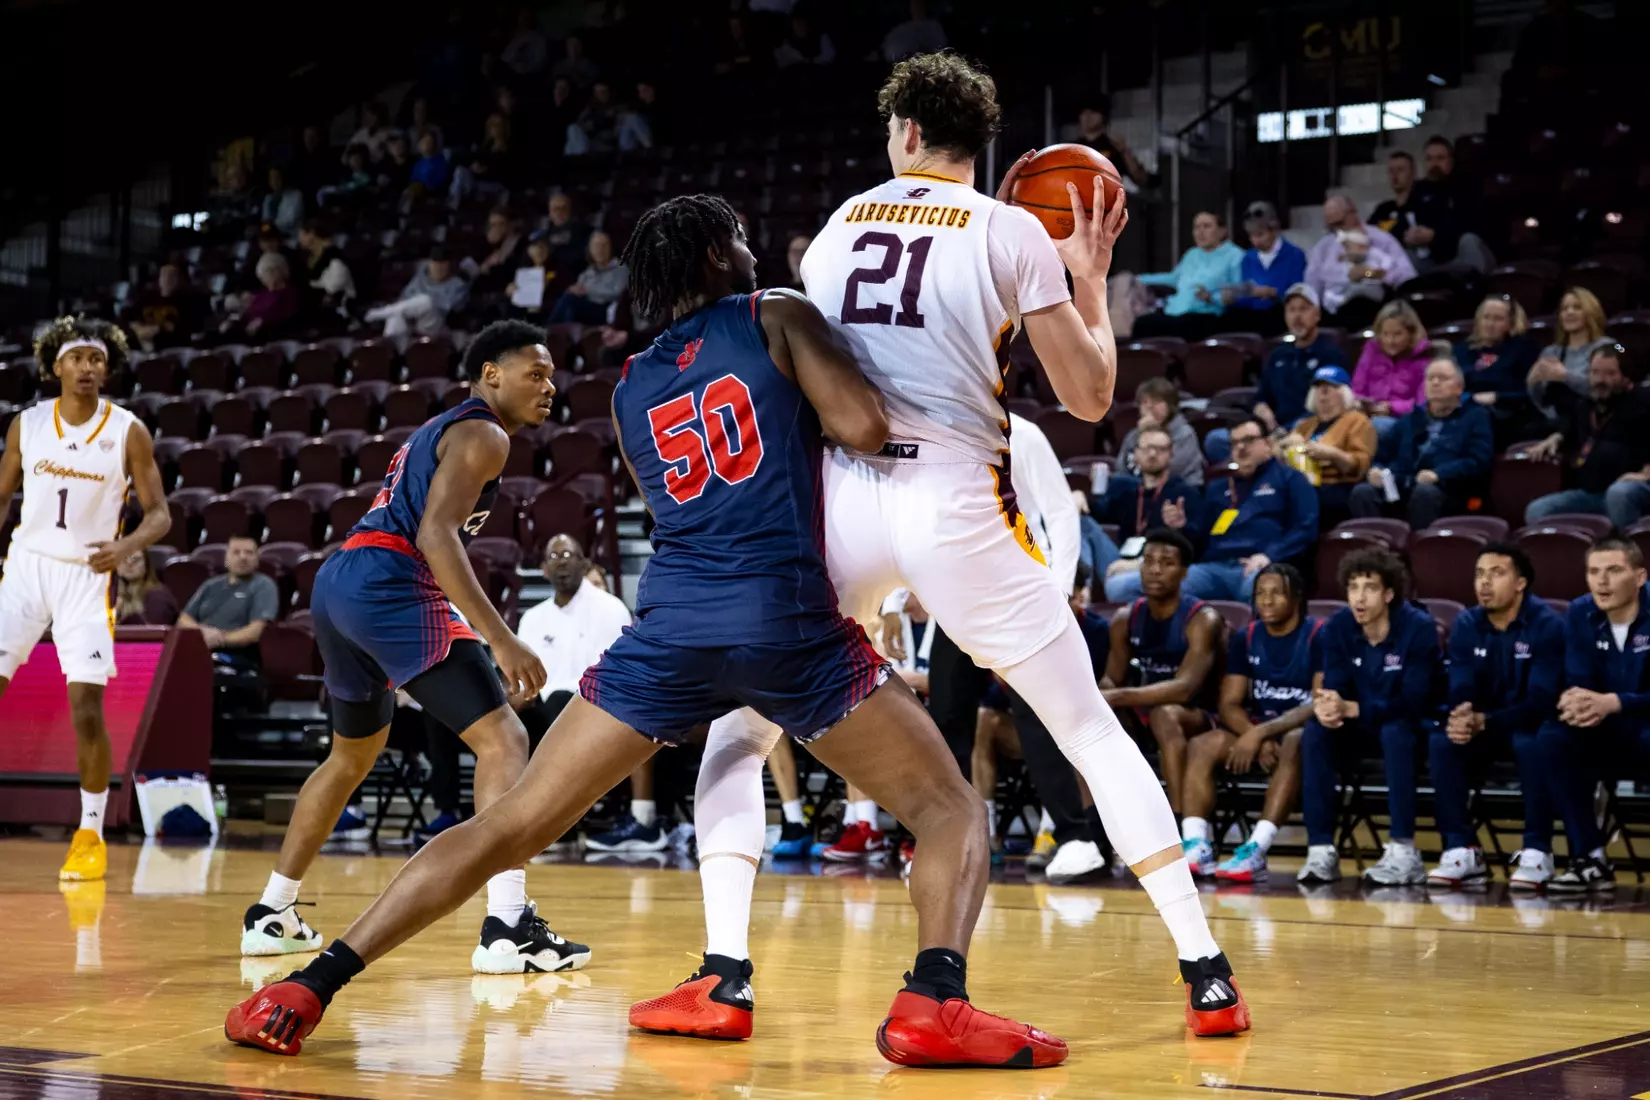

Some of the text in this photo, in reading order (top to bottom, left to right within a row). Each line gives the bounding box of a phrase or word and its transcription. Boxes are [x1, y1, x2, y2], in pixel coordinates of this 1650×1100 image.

[845, 202, 972, 229] JARUSEVICIUS
[841, 231, 934, 328] 21
[647, 373, 764, 505] 50
[55, 487, 69, 530] 1
